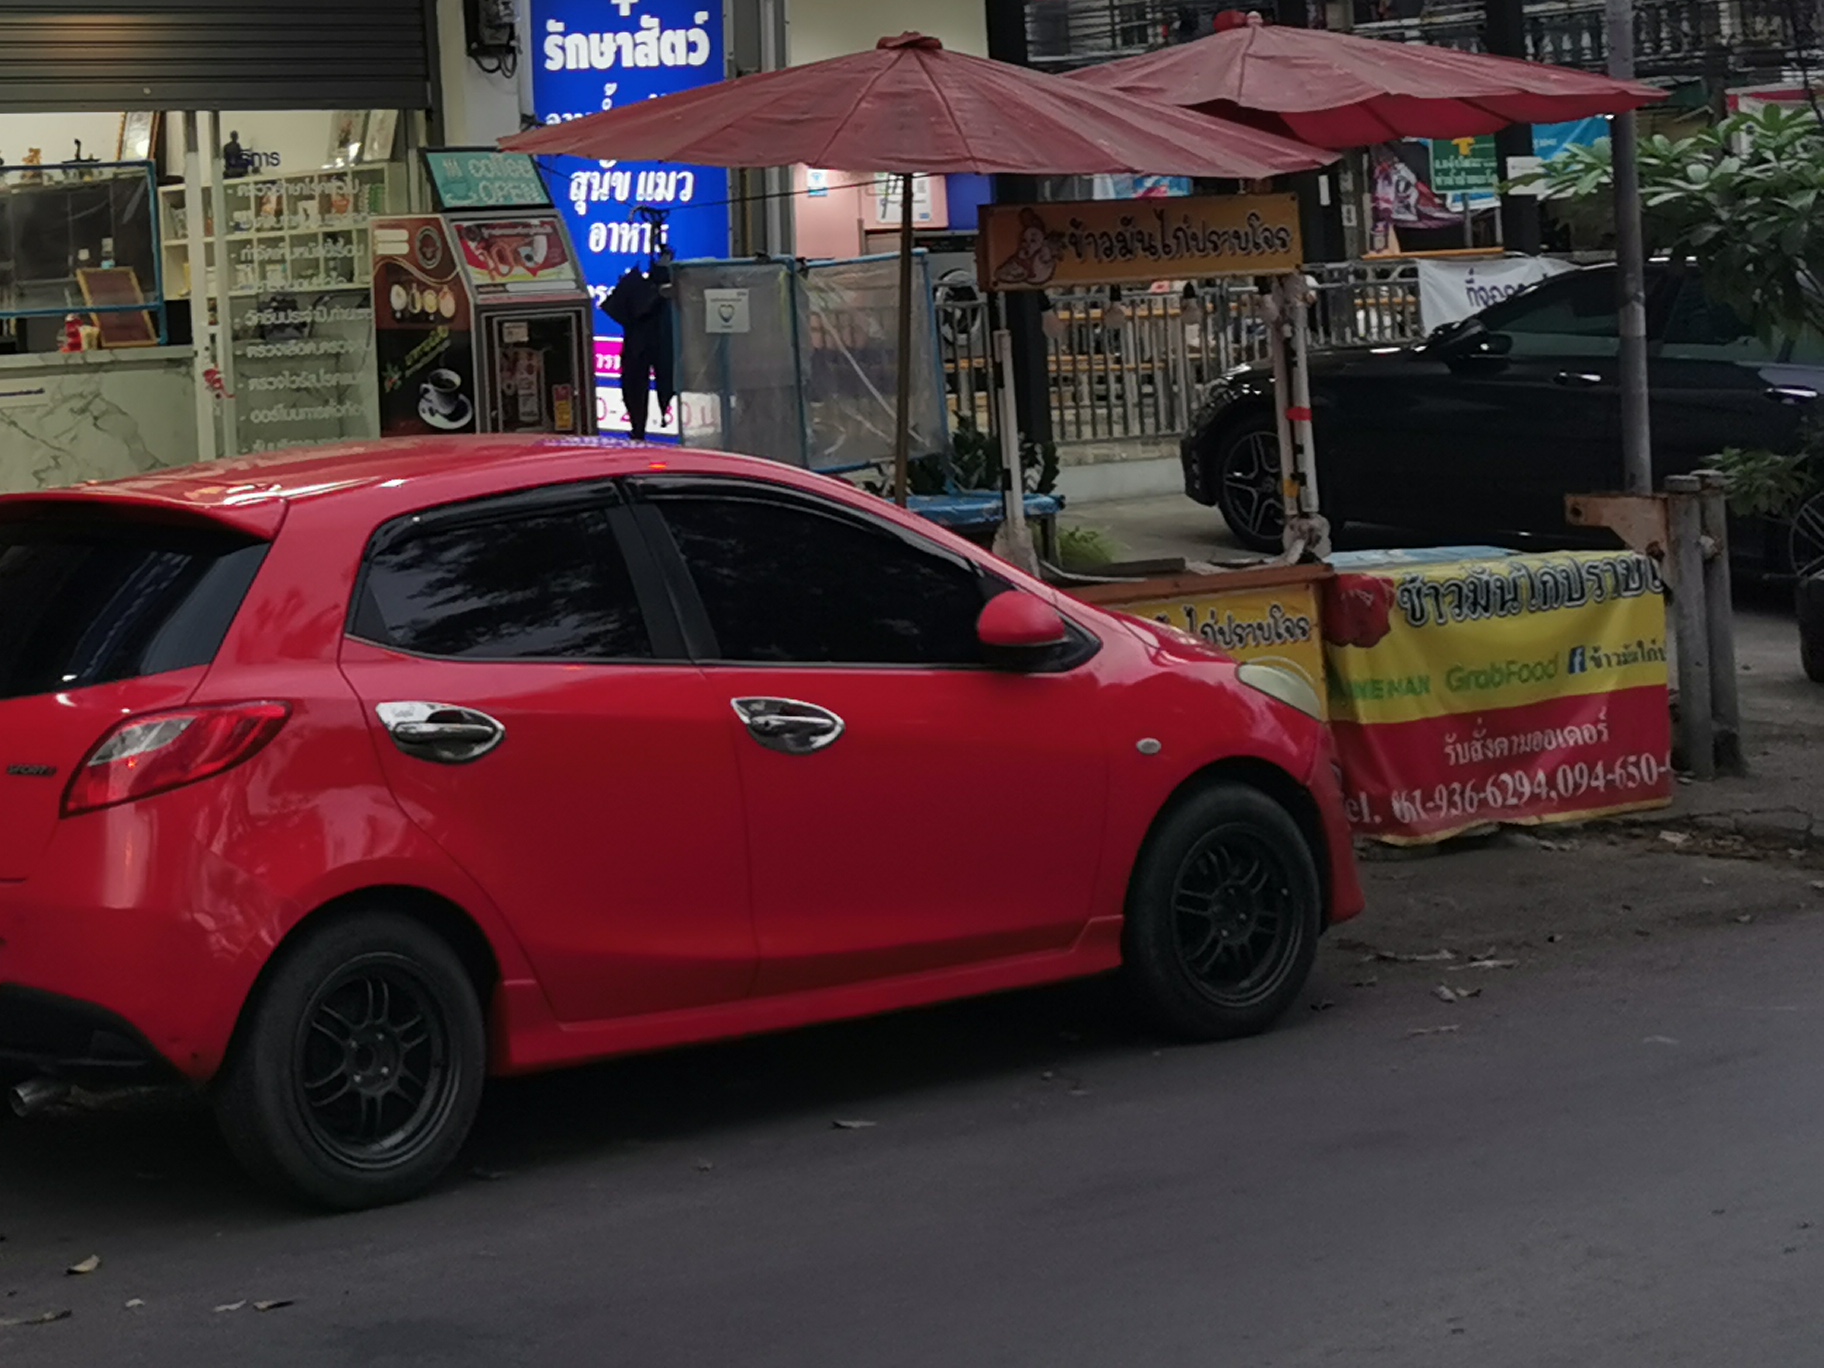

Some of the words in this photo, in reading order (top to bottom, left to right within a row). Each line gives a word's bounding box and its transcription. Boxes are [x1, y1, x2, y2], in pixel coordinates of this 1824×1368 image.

[543, 11, 711, 71] รักษาสัตว์
[636, 170, 694, 202] แมว
[1445, 652, 1560, 694] GrabFood
[1343, 794, 1381, 824] el.
